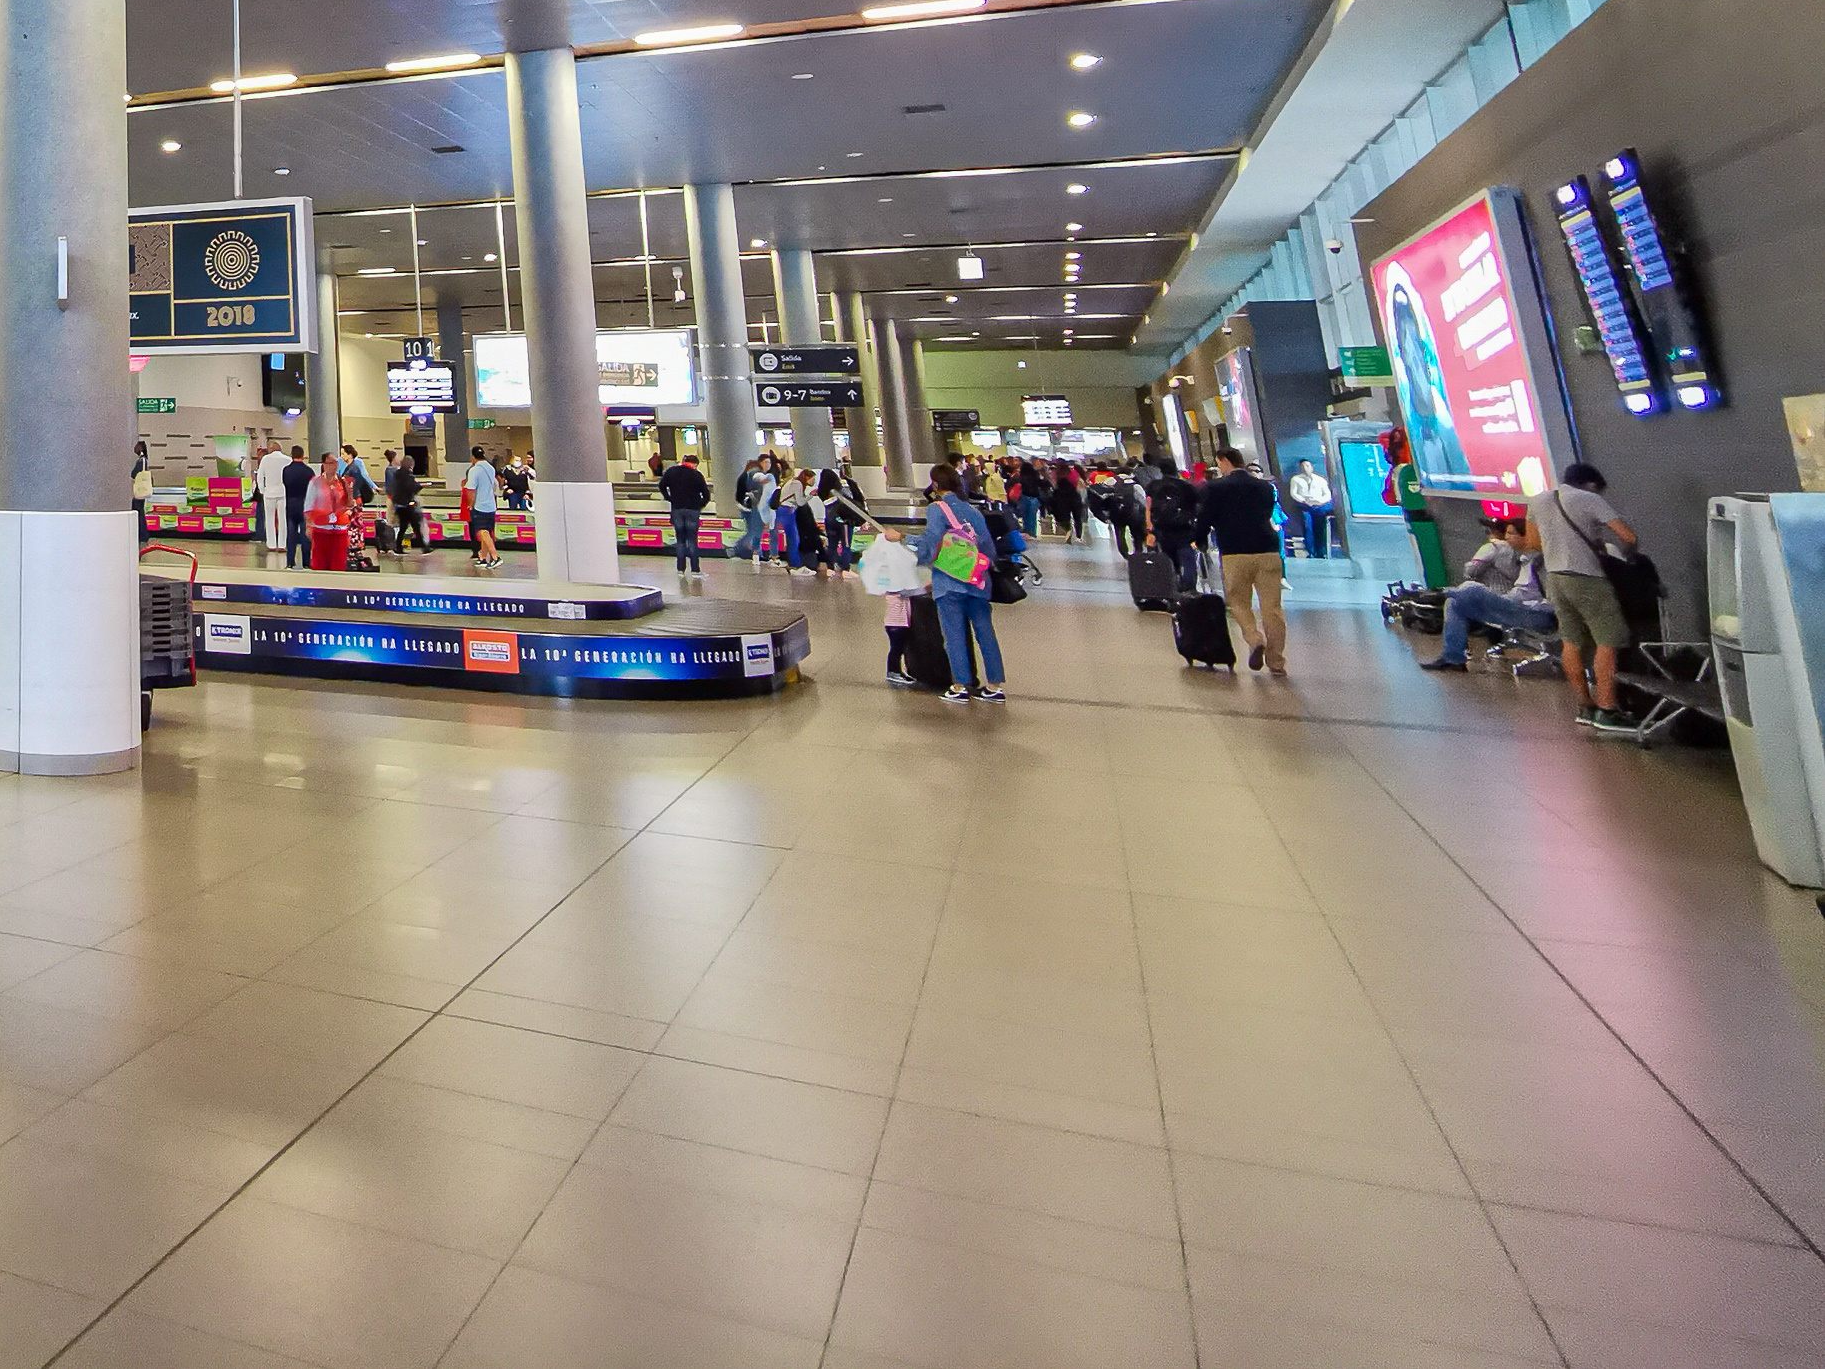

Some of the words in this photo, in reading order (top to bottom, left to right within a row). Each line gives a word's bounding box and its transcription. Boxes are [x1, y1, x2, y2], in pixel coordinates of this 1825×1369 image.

[207, 304, 256, 327] 2018
[405, 342, 422, 357] 10
[784, 390, 807, 401] 9-7
[346, 595, 358, 604] LA
[476, 602, 524, 614] LLEGADO
[254, 630, 267, 641] LA
[298, 633, 374, 649] GENERACIÓN
[404, 639, 460, 655] LLEGADO
[521, 647, 537, 661] LA
[575, 648, 663, 665] GENERACIÓN
[671, 651, 686, 664] HA
[693, 650, 741, 663] LLEGADO
